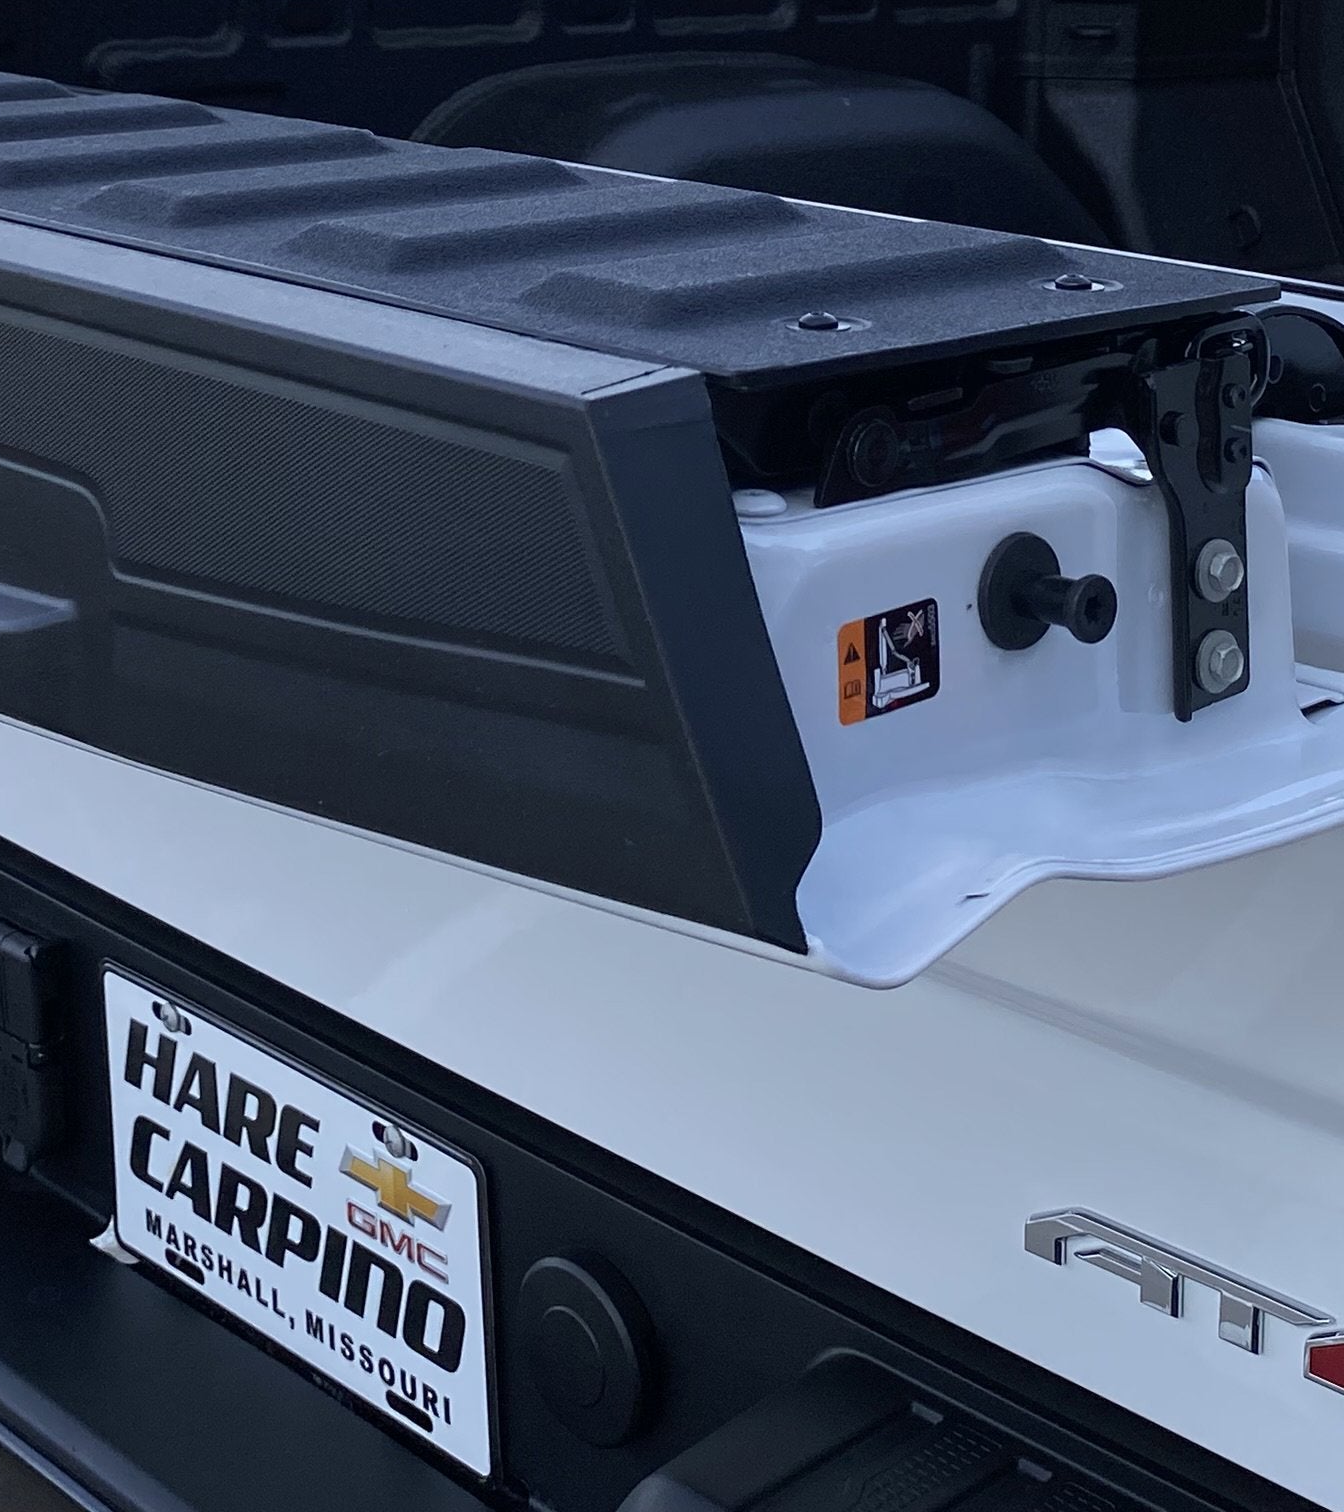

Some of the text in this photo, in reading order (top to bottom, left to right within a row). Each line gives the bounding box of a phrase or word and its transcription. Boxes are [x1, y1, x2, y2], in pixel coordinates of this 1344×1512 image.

[124, 1017, 321, 1189] HARE
[129, 1115, 466, 1374] CARPINO
[145, 1207, 452, 1426] MARSHALL, MISSOURI
[345, 1197, 450, 1286] GMC
